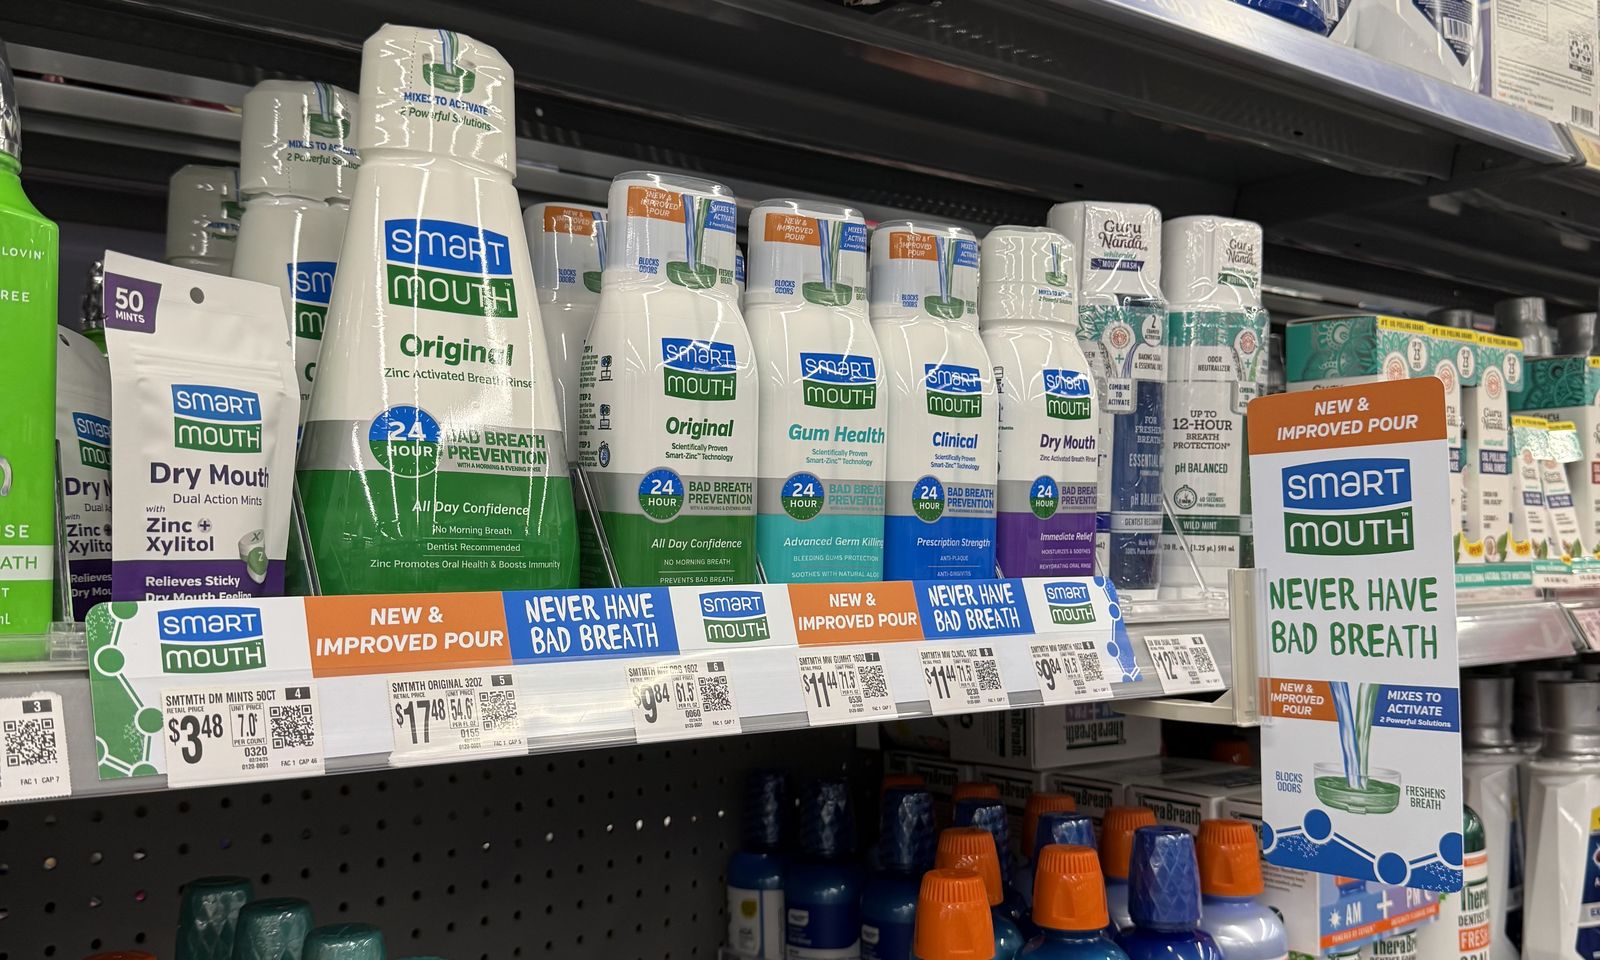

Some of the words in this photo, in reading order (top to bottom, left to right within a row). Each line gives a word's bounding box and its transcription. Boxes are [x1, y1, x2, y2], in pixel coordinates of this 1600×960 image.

[436, 96, 447, 106] TO
[449, 99, 488, 116] ACTIVATE
[400, 107, 406, 116] 2
[408, 107, 450, 123] Powerful
[1104, 220, 1141, 234] Guru
[115, 287, 144, 312] 50
[115, 310, 146, 324] MINTS
[400, 334, 514, 366] Original
[1198, 363, 1230, 372] NEUTRALIZER
[384, 367, 410, 379] Zinc
[413, 369, 465, 382] Activated
[1314, 398, 1353, 416] NEW
[1356, 397, 1370, 411] &
[1190, 410, 1202, 418] UP
[1204, 410, 1217, 418] TO
[666, 417, 734, 439] Original
[1172, 418, 1233, 431] 12-HOUR
[1277, 419, 1363, 441] IMPROVED
[1368, 415, 1419, 433] POUR
[390, 421, 426, 442] 24
[789, 424, 830, 442] Gum
[835, 426, 885, 444] Health
[1186, 433, 1220, 441] BREATH
[449, 430, 480, 446] BAD
[485, 431, 545, 449] BREATH
[932, 431, 978, 449] Clinical
[1040, 434, 1061, 452] Dry
[1063, 435, 1096, 450] Mouth
[387, 445, 433, 457] HOUR
[448, 445, 547, 464] PREVENTION
[671, 443, 707, 453] Scientifically
[708, 444, 728, 452] Proven
[701, 453, 733, 462] Technology
[1175, 464, 1186, 475] pH
[1187, 463, 1228, 474] BALANCED
[150, 462, 201, 490] Dry
[210, 464, 269, 488] Mouth
[651, 480, 674, 495] 24
[688, 481, 713, 493] BAD
[715, 482, 752, 493] BREATH
[793, 483, 815, 497] 24
[921, 486, 937, 500] 24
[948, 487, 963, 497] BAD
[965, 488, 994, 498] BREATH
[1038, 485, 1052, 498] 24
[173, 494, 200, 505] Dual
[204, 494, 237, 505] Action
[240, 495, 262, 506] Mints
[648, 497, 677, 507] HOUR
[688, 493, 753, 505] PREVENTION
[790, 499, 817, 508] HOUR
[948, 498, 994, 509] PREVENTION
[1036, 500, 1054, 508] HOUR
[146, 505, 165, 513] with
[412, 501, 431, 513] All
[435, 502, 459, 516] Day
[463, 502, 530, 516] Confidence
[919, 502, 939, 510] HOUR
[147, 517, 192, 533] Zinc
[436, 525, 447, 534] No
[450, 525, 479, 536] Morning
[481, 526, 512, 535] Breath
[1184, 521, 1200, 530] WILD
[1201, 521, 1217, 530] MINT
[784, 537, 832, 547] Advanced
[835, 537, 858, 547] Germ
[917, 537, 960, 548] Prescription
[962, 538, 991, 548] Strength
[1040, 532, 1074, 542] Immediate
[1076, 532, 1093, 542] Relief
[146, 536, 214, 554] Xylitol
[427, 542, 457, 552] Dentist
[460, 543, 520, 552] Recommended
[651, 538, 666, 548] All
[668, 538, 688, 551] Day
[690, 538, 742, 549] Confidence
[370, 559, 389, 568] Zinc
[394, 559, 440, 569] Promotes
[442, 559, 460, 569] Oral
[462, 559, 488, 569] Health
[490, 560, 497, 569] &
[499, 559, 527, 569] Boosts
[528, 560, 561, 570] Immunity
[675, 558, 705, 566] MORNING
[145, 576, 202, 588] Relieves
[204, 575, 240, 590] Sticky
[829, 593, 863, 608] NEW
[866, 592, 877, 606] &
[928, 583, 978, 608] NEVER
[981, 582, 1015, 603] HAVE
[1269, 577, 1359, 611] NEVER
[1367, 576, 1438, 612] HAVE
[525, 594, 597, 624] NEVER
[604, 592, 655, 619] HAVE
[370, 607, 423, 627] NEW
[428, 606, 443, 623] &
[798, 614, 874, 632] IMPROVED
[878, 612, 918, 627] POUR
[934, 607, 963, 632] BAD
[966, 605, 1020, 630] BREATH
[316, 634, 438, 657] IMPROVED
[443, 630, 505, 650] POUR
[531, 625, 573, 655] BAD
[580, 621, 660, 651] BREATH
[1271, 620, 1318, 655] BAD
[1330, 622, 1438, 659] BREATH
[392, 681, 426, 692] SMTMTH
[428, 679, 463, 690] ORIGINAL
[1280, 683, 1304, 692] NEW
[1305, 683, 1313, 692] &
[166, 693, 205, 706] SMTMTH
[209, 692, 223, 704] DM
[226, 691, 254, 703] MINTS
[256, 690, 277, 701] 50CT
[294, 688, 301, 698] 4
[1270, 693, 1325, 705] IMPROVED
[1387, 690, 1423, 702] MIXES
[1425, 692, 1441, 703] TO
[1282, 705, 1312, 715] POUR
[1387, 704, 1443, 717] ACTIVATE
[1385, 717, 1415, 726] Powerful
[1417, 718, 1451, 728] Solutions
[245, 746, 267, 757] 0320
[1275, 770, 1303, 783] BLOCKS
[1277, 782, 1302, 794] ODORS
[1405, 785, 1446, 800] FRESHENS
[1410, 797, 1442, 810] BREATH
[1346, 901, 1362, 926] AM
